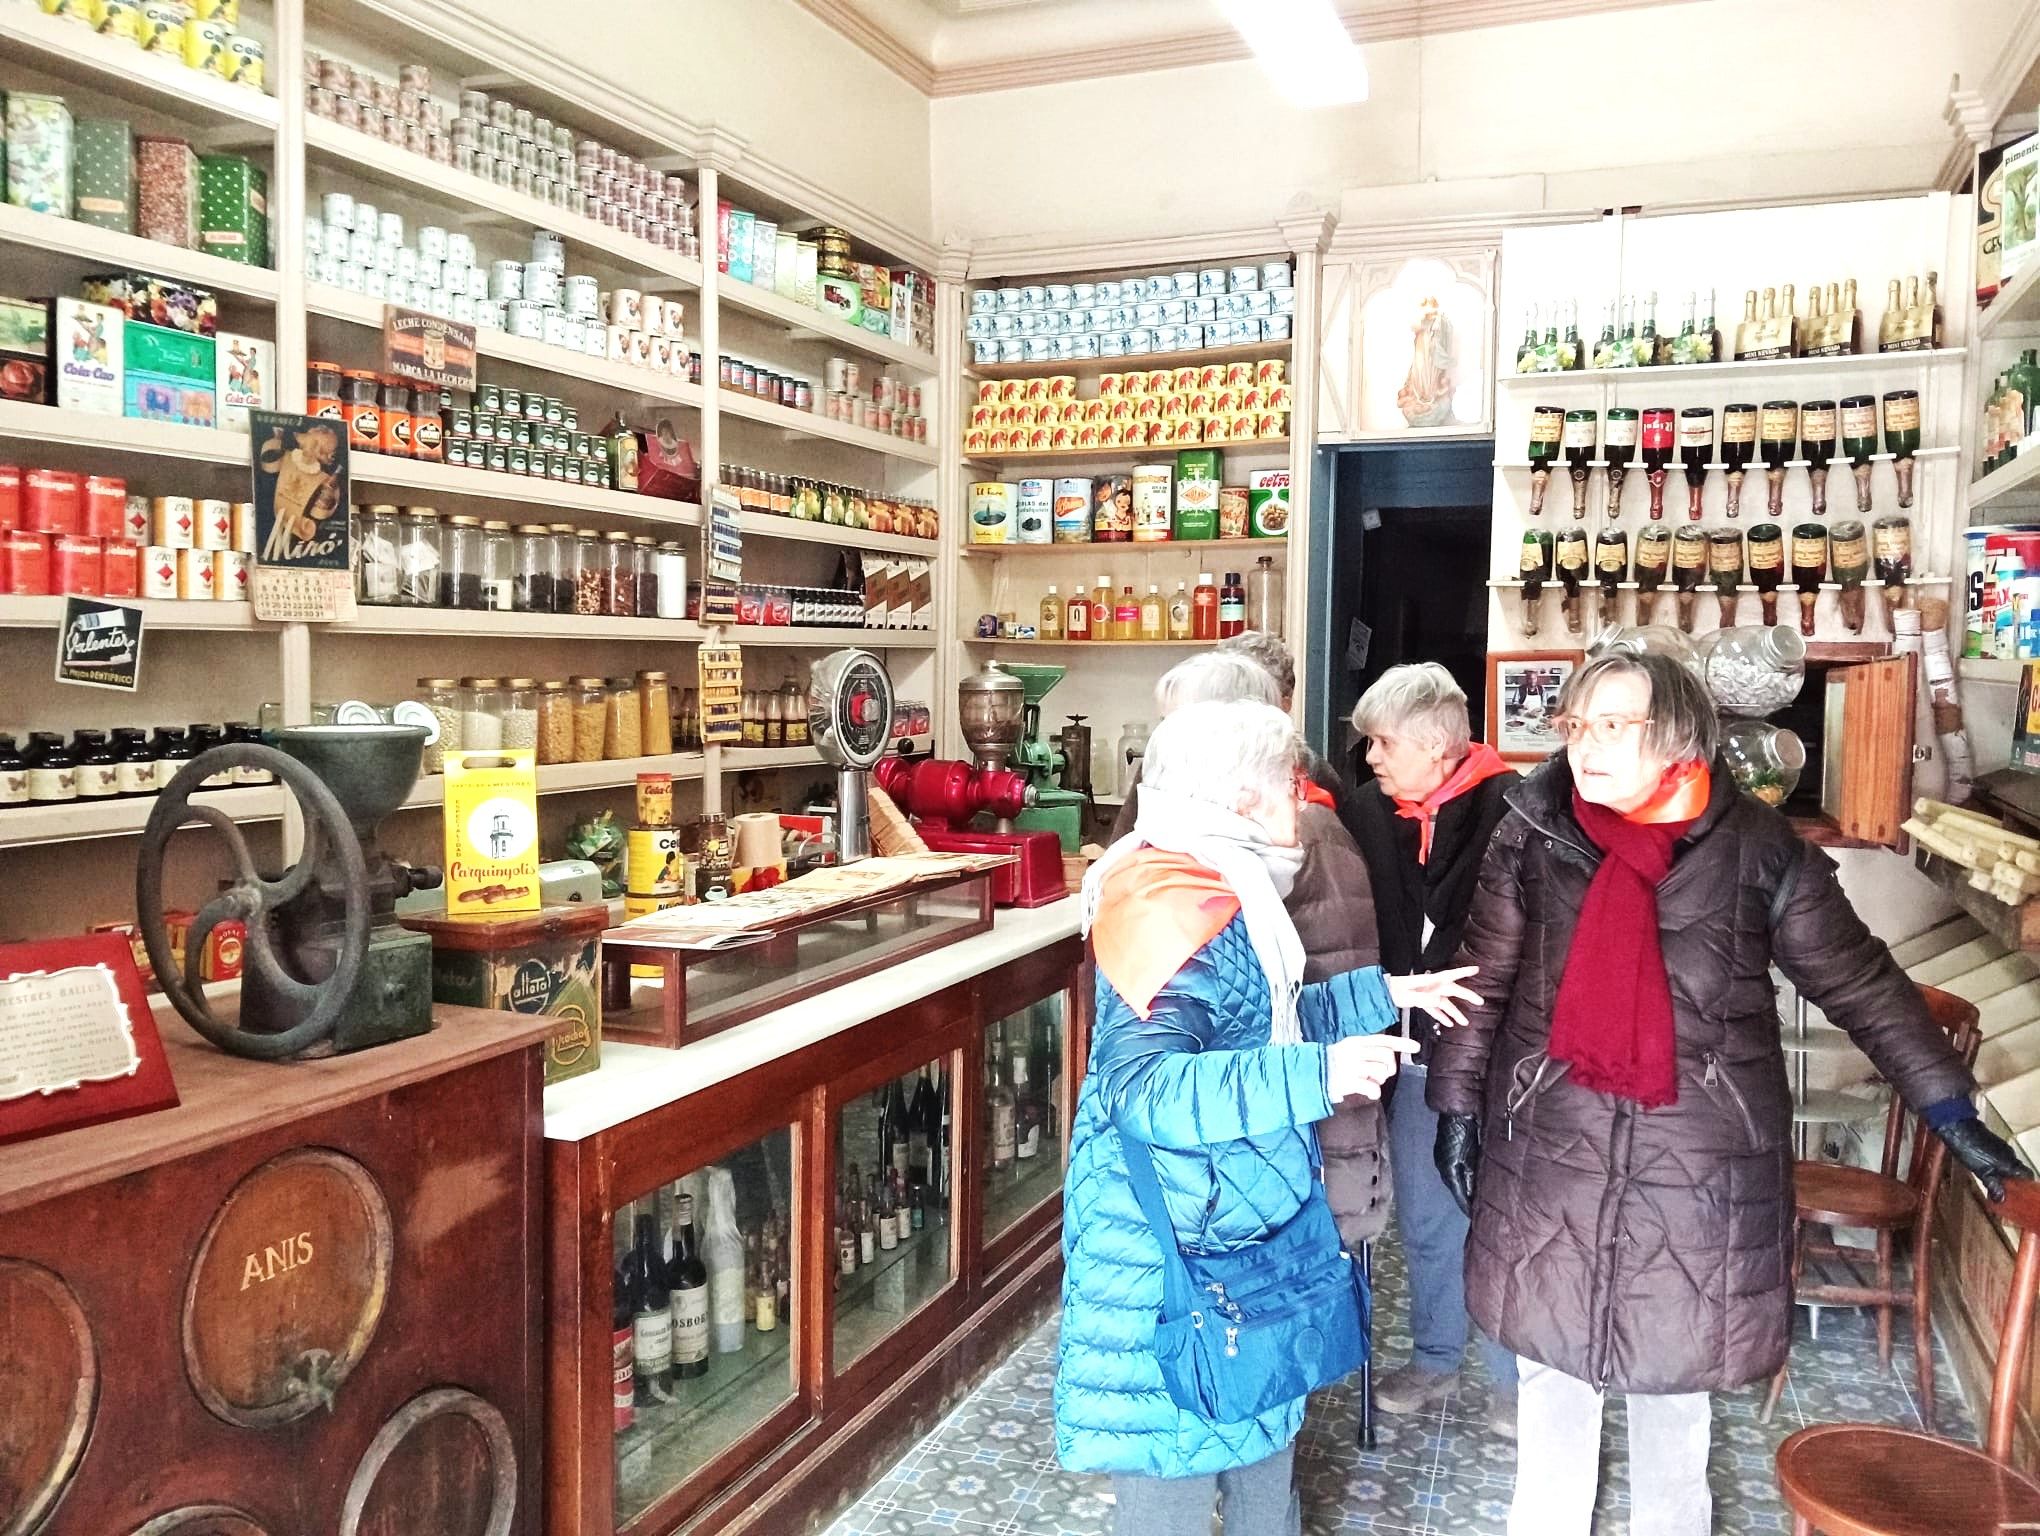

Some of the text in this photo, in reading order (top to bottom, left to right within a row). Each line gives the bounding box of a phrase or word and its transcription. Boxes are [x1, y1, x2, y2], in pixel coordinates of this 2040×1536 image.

[392, 317, 420, 331] LECHE
[392, 361, 422, 377] MARCA
[424, 368, 435, 380] LA
[89, 670, 133, 684] DENTIFRICO
[450, 861, 536, 883] Carquinyolis
[240, 1231, 313, 1292] ANIS
